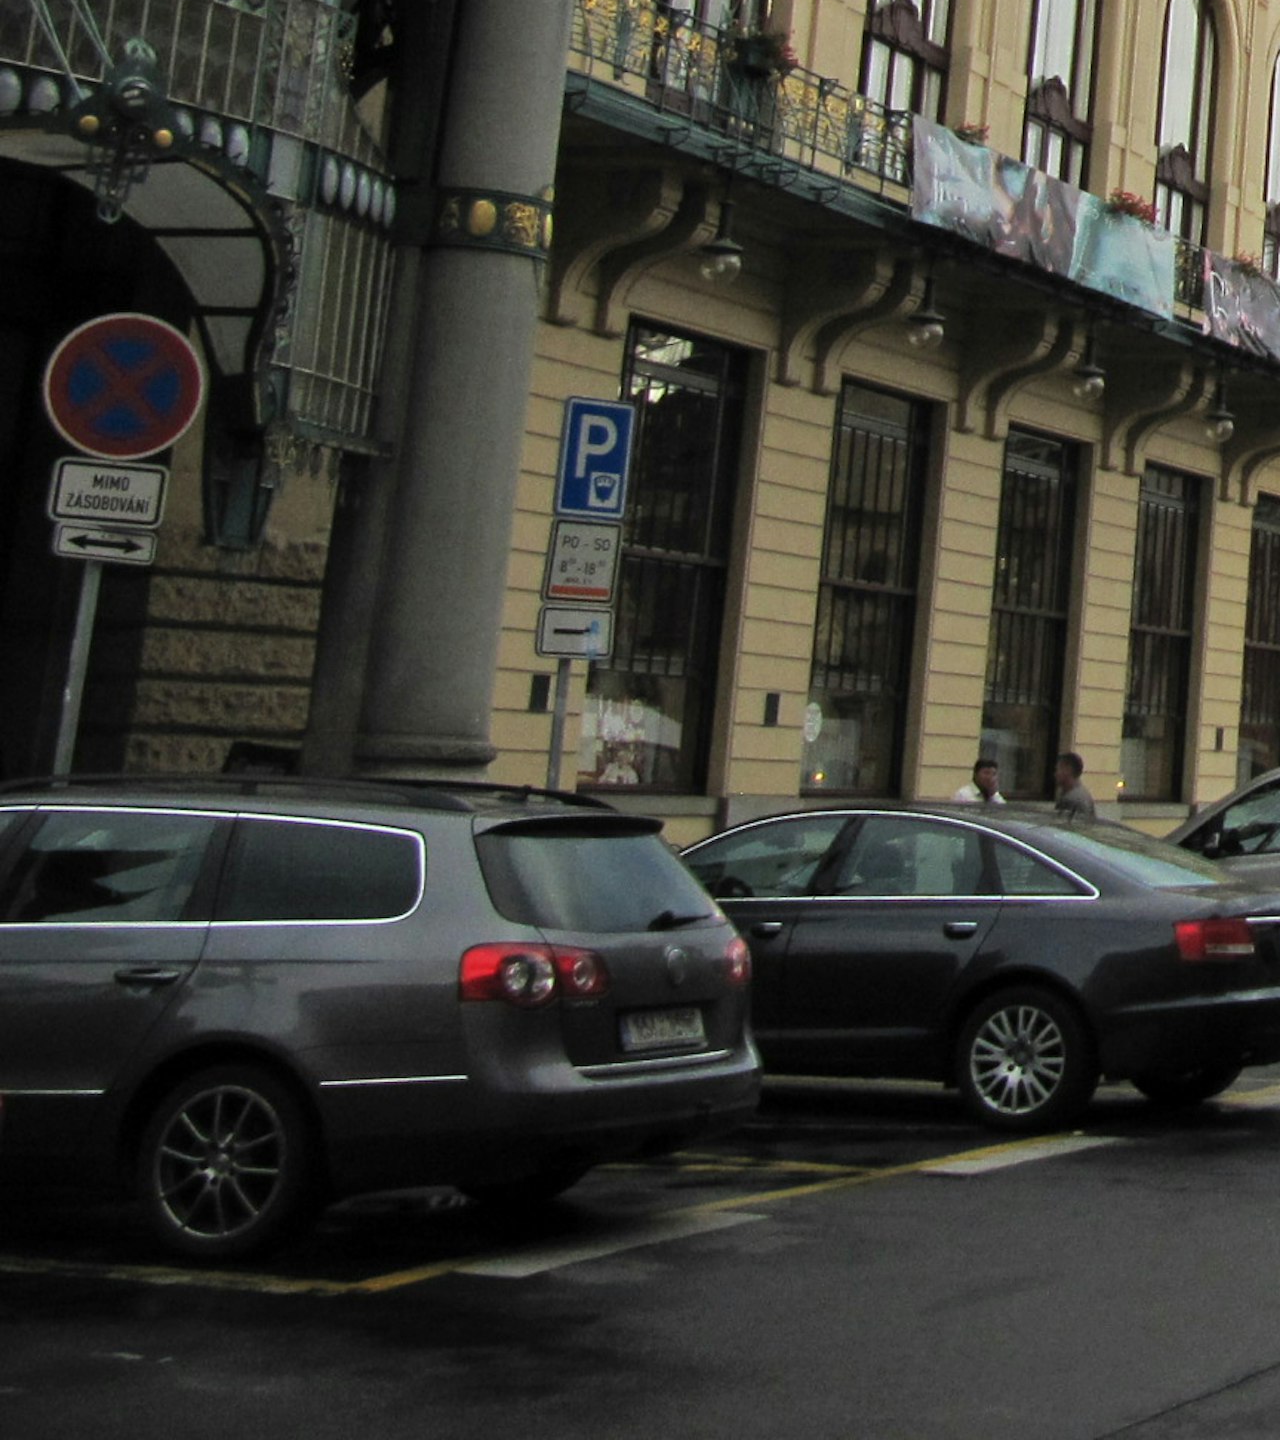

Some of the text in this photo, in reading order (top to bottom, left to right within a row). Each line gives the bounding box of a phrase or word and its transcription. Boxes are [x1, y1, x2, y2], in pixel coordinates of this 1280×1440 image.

[575, 413, 618, 478] P
[92, 474, 130, 492] MIMO
[66, 491, 152, 515] ZÁSOBOVÁNÍ
[561, 535, 580, 549] PO
